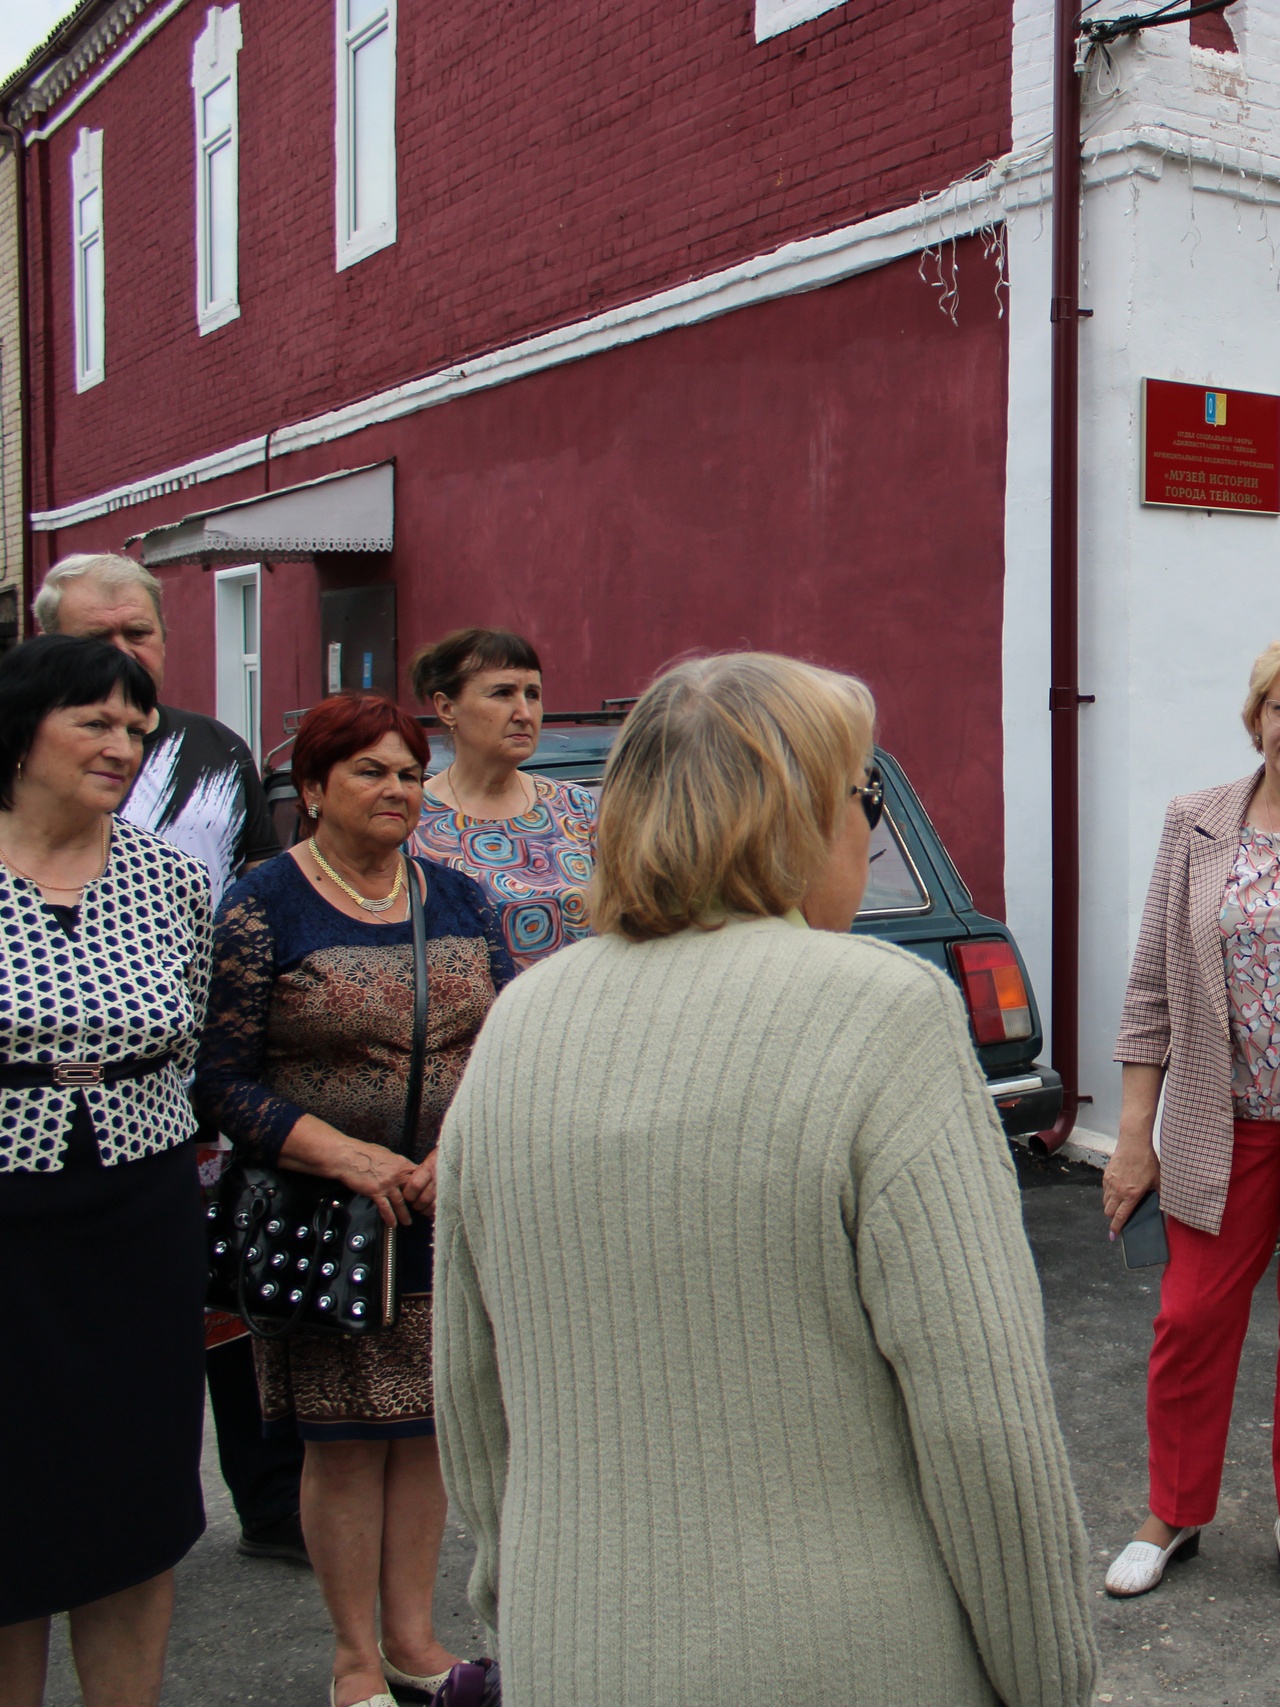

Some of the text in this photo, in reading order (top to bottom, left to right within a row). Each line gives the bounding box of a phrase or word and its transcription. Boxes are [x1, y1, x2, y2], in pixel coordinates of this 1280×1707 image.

[1164, 469, 1259, 489] «МУЗЕЙ ИСТОРИИ
[1165, 486, 1263, 505] ГОРОДА ТЕЙКОВО»
